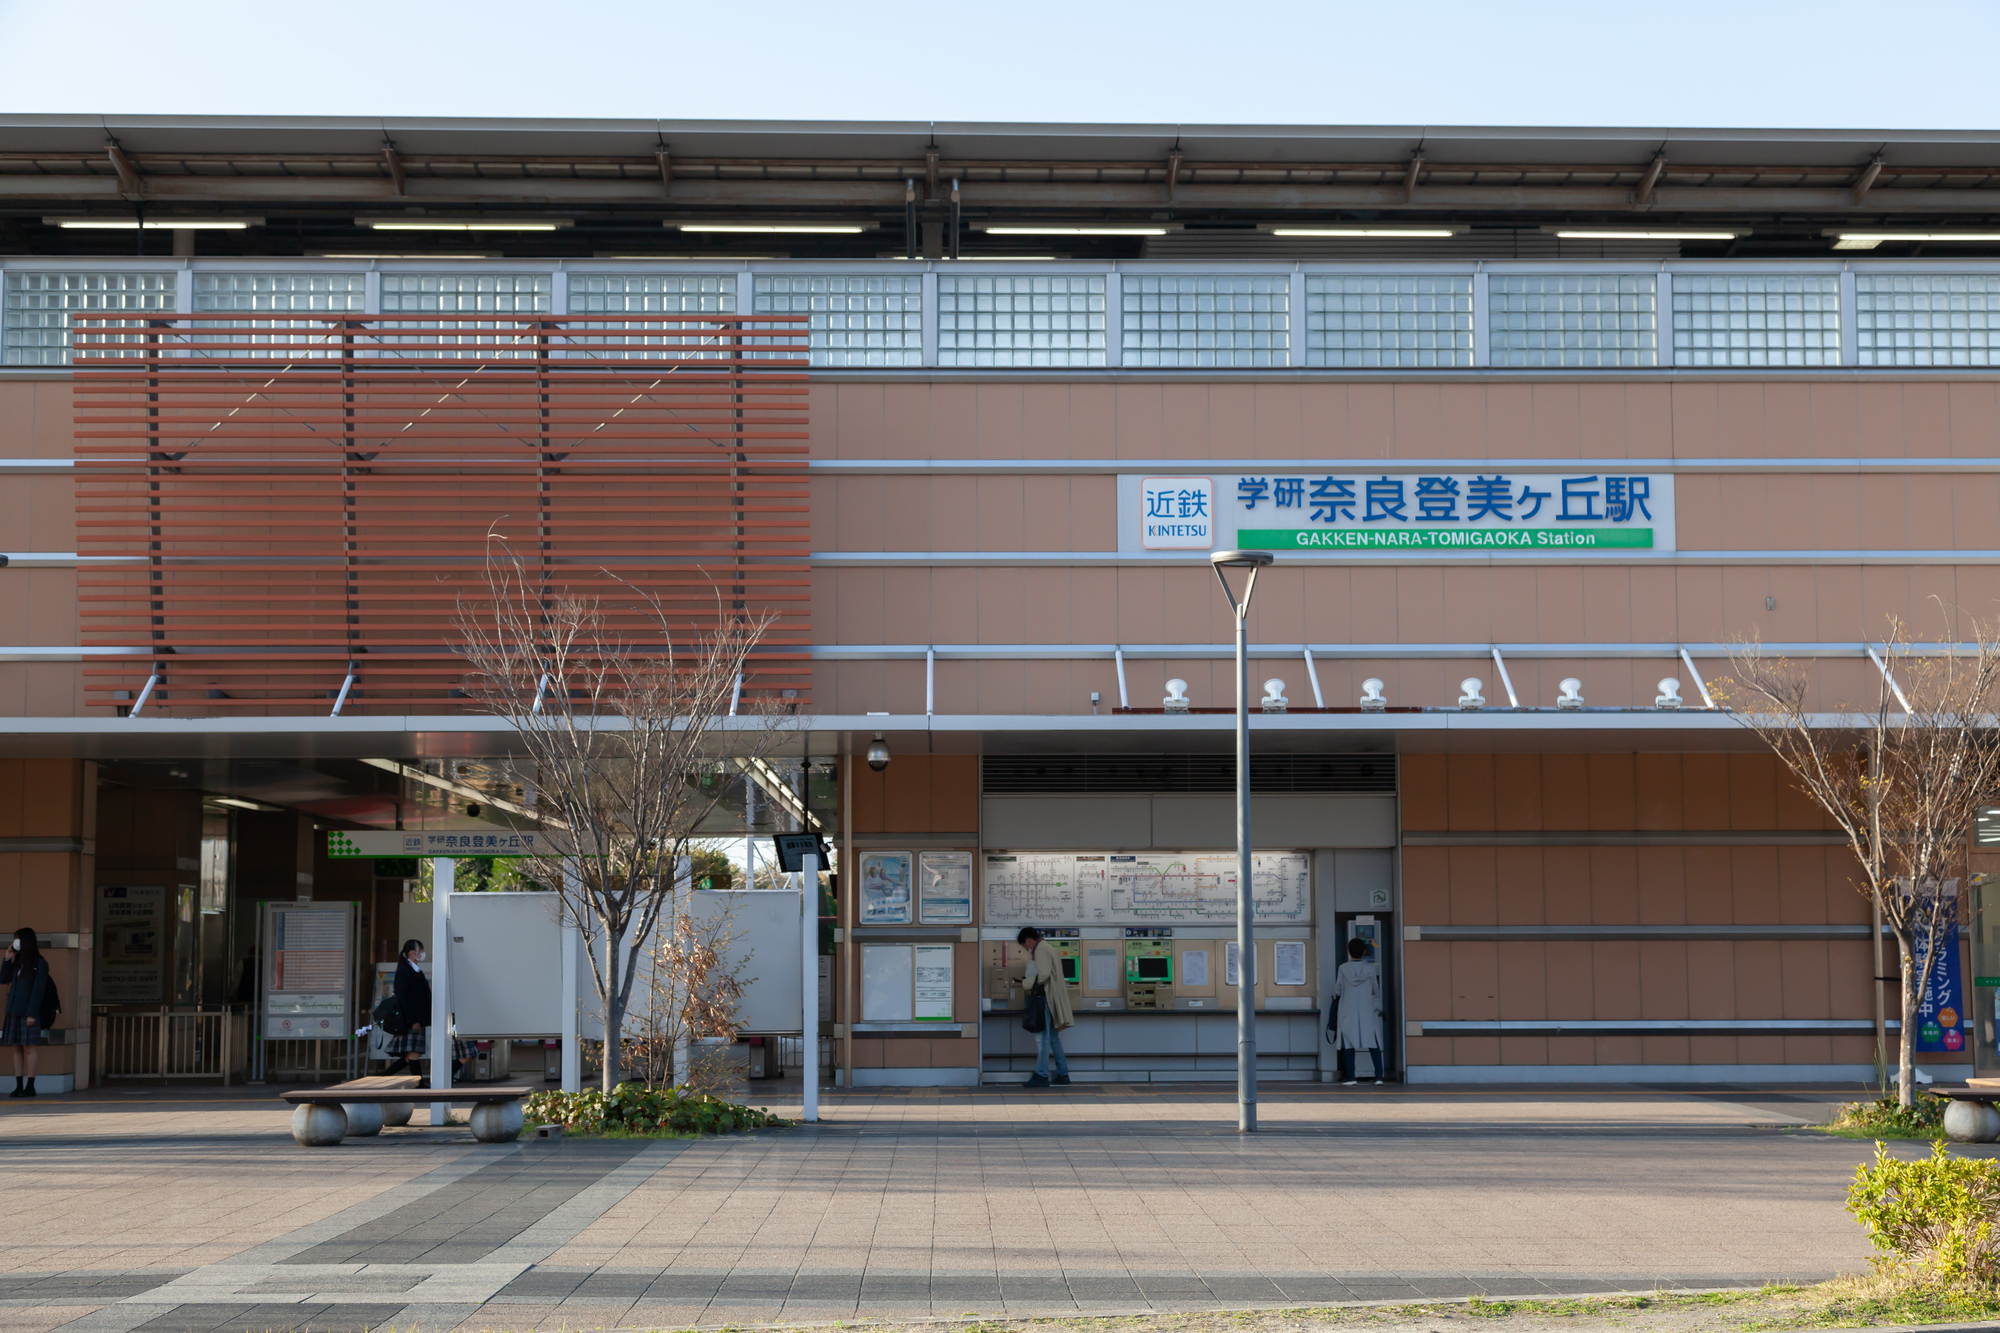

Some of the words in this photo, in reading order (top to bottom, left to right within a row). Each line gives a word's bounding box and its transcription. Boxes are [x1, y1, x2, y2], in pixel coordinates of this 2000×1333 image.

[1147, 489, 1208, 518] 近鉄
[1238, 476, 1652, 522] 学研奈良登美ヶ丘駅
[1148, 525, 1206, 537] KINTETSU
[1296, 531, 1532, 546] GAKKEN-NARA-TOMIGAOKA
[1537, 531, 1596, 546] Station
